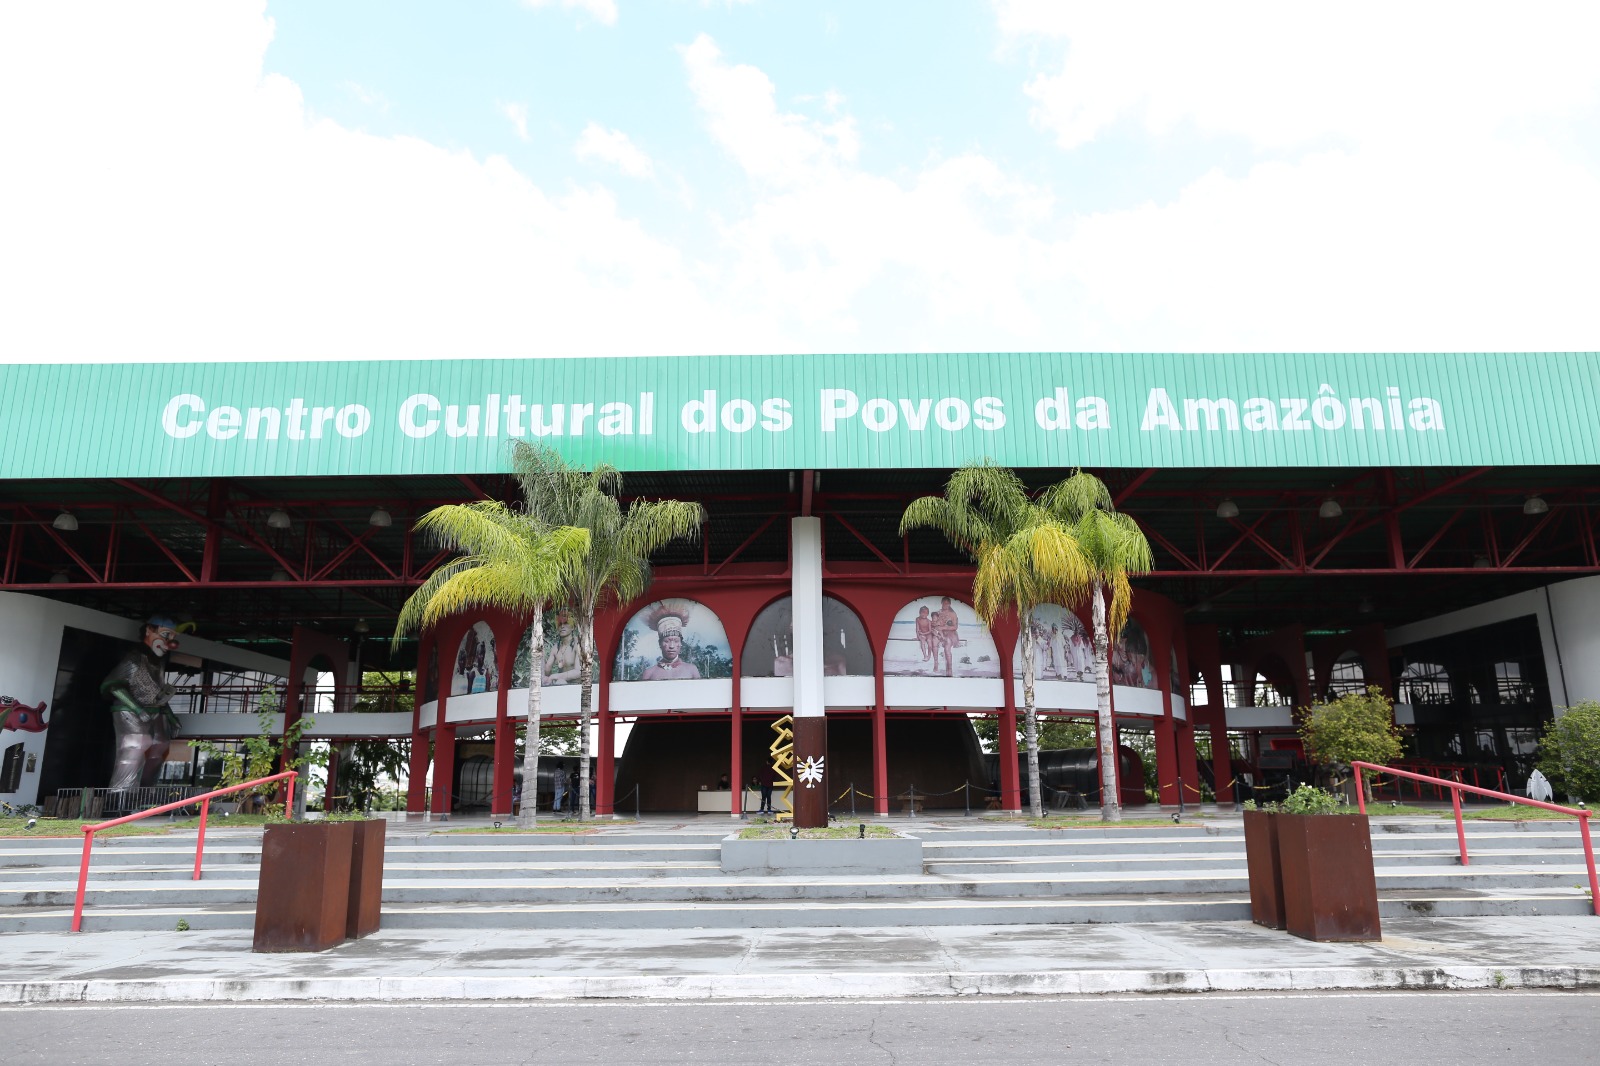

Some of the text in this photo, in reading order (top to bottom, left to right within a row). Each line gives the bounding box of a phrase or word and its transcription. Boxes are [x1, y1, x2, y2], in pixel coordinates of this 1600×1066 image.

[161, 383, 1446, 441] Centro Cultural dos Povos da Amazônia
